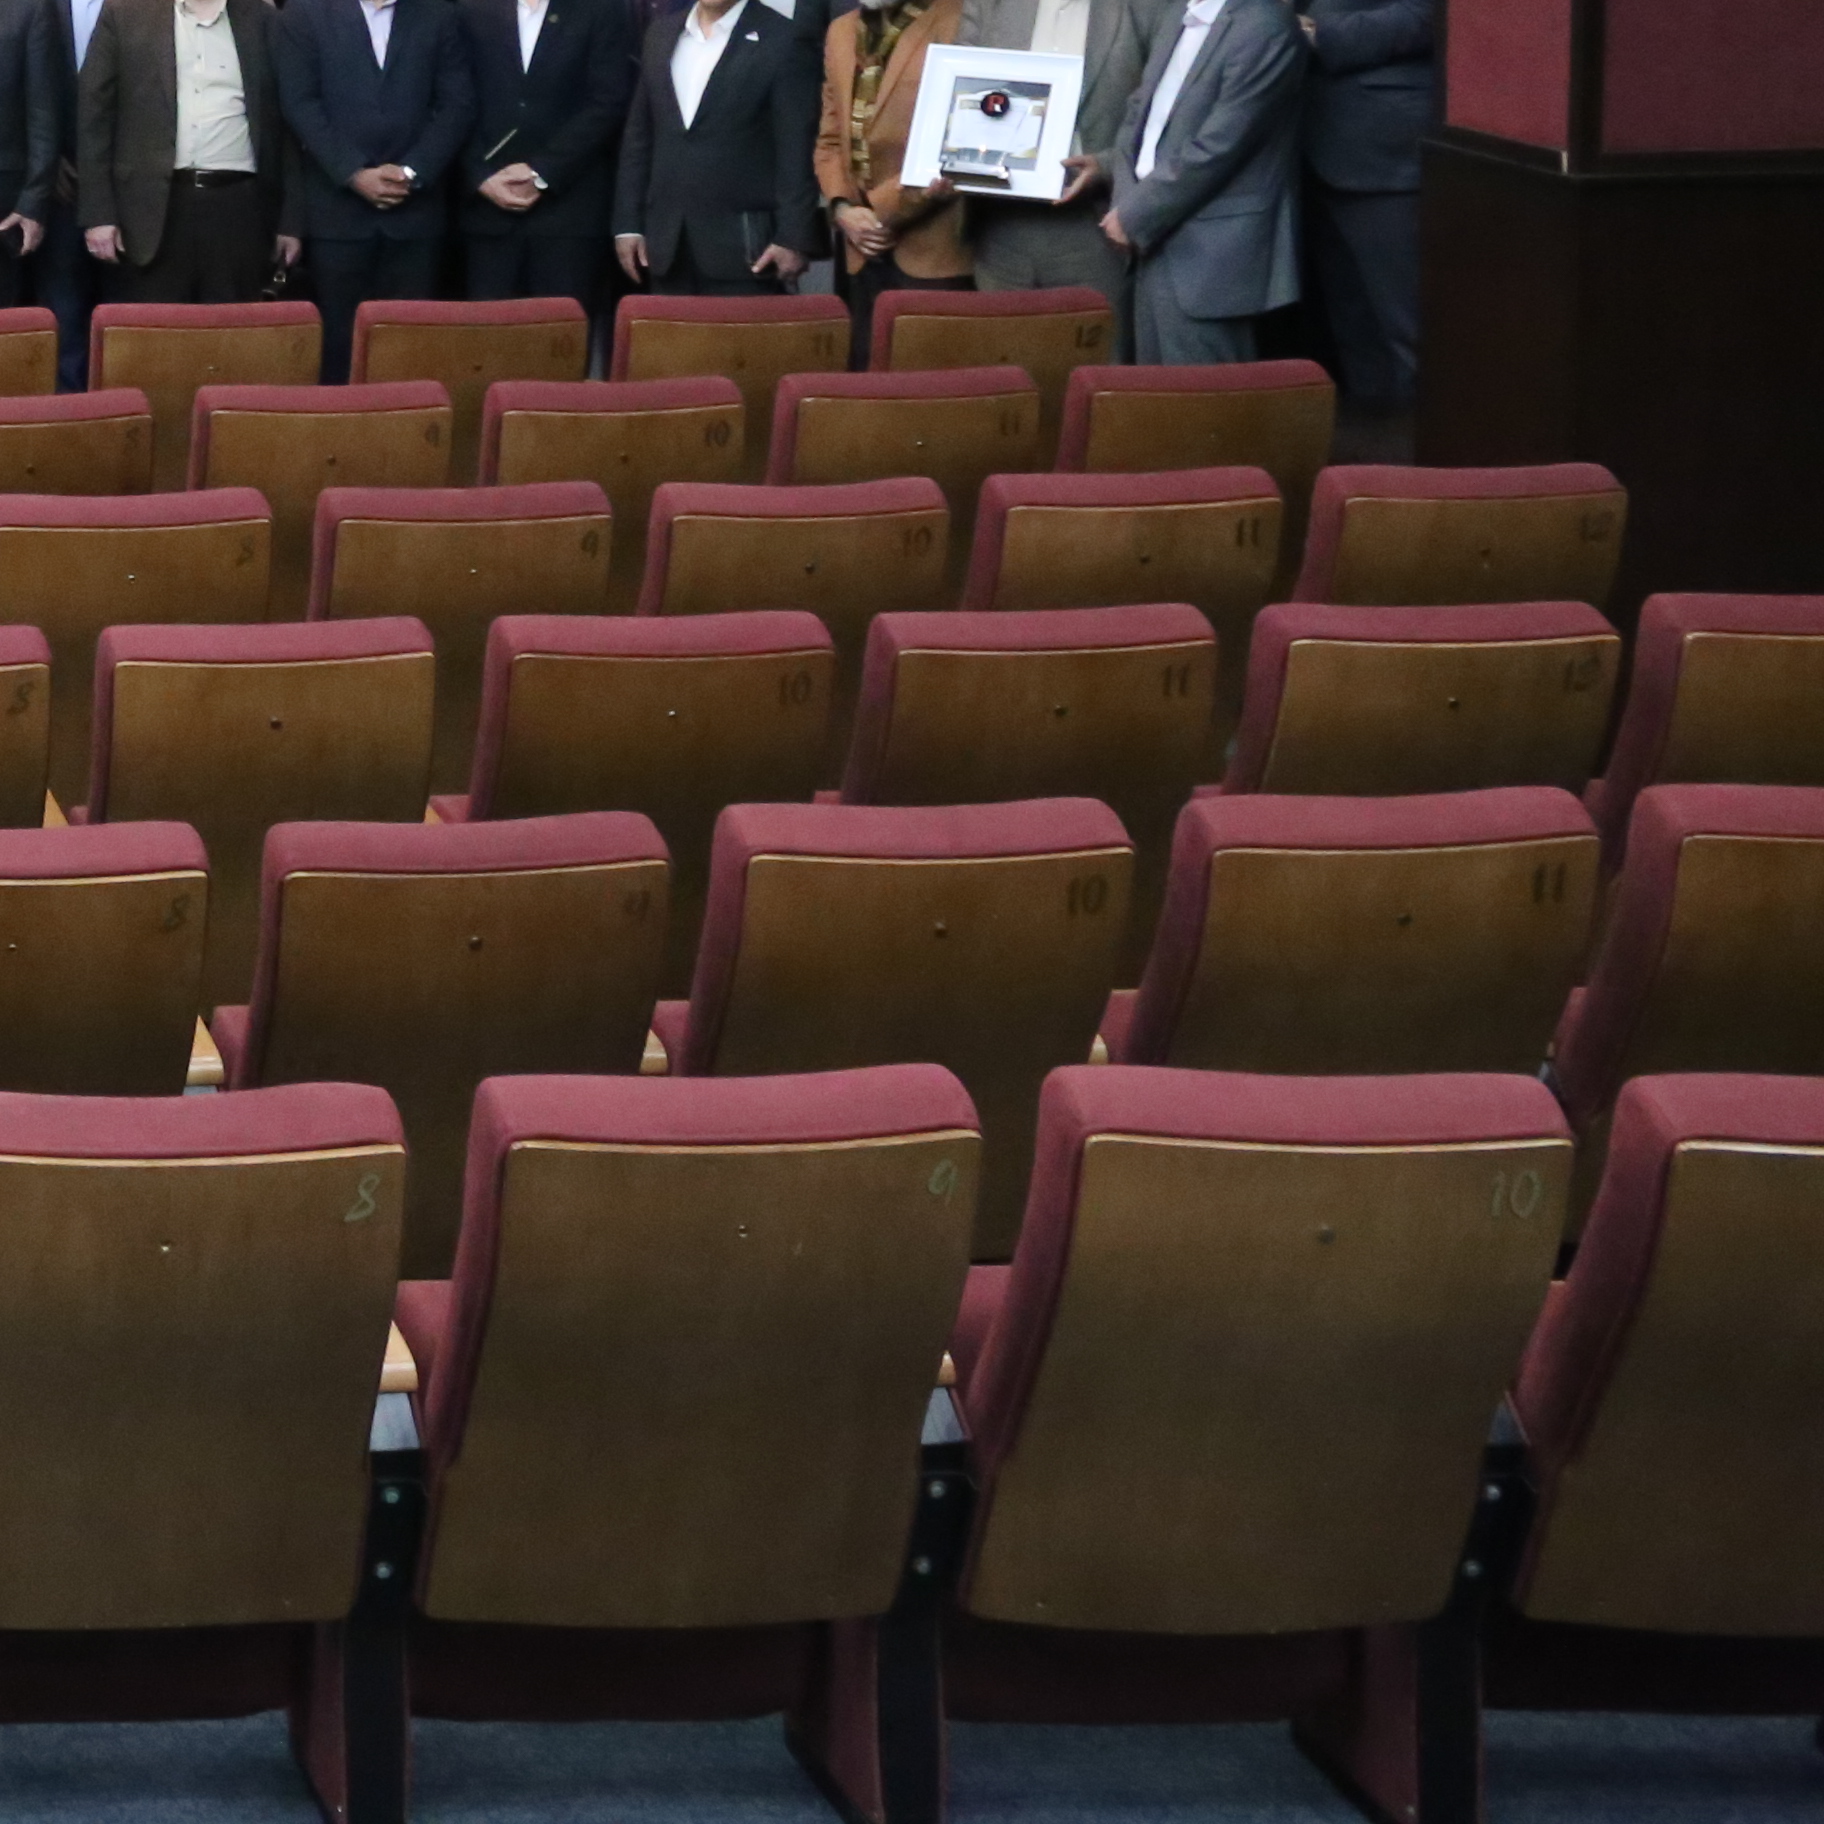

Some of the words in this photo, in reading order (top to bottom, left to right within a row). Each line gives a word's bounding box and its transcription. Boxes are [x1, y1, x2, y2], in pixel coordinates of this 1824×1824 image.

[702, 417, 731, 449] 10
[903, 525, 933, 558] 10
[776, 669, 812, 708] 10
[1162, 662, 1191, 698] 11
[1068, 873, 1108, 918] 10
[1532, 861, 1568, 904] 11
[158, 892, 190, 935] 8
[927, 1158, 959, 1207] 9
[1490, 1168, 1543, 1219] 10
